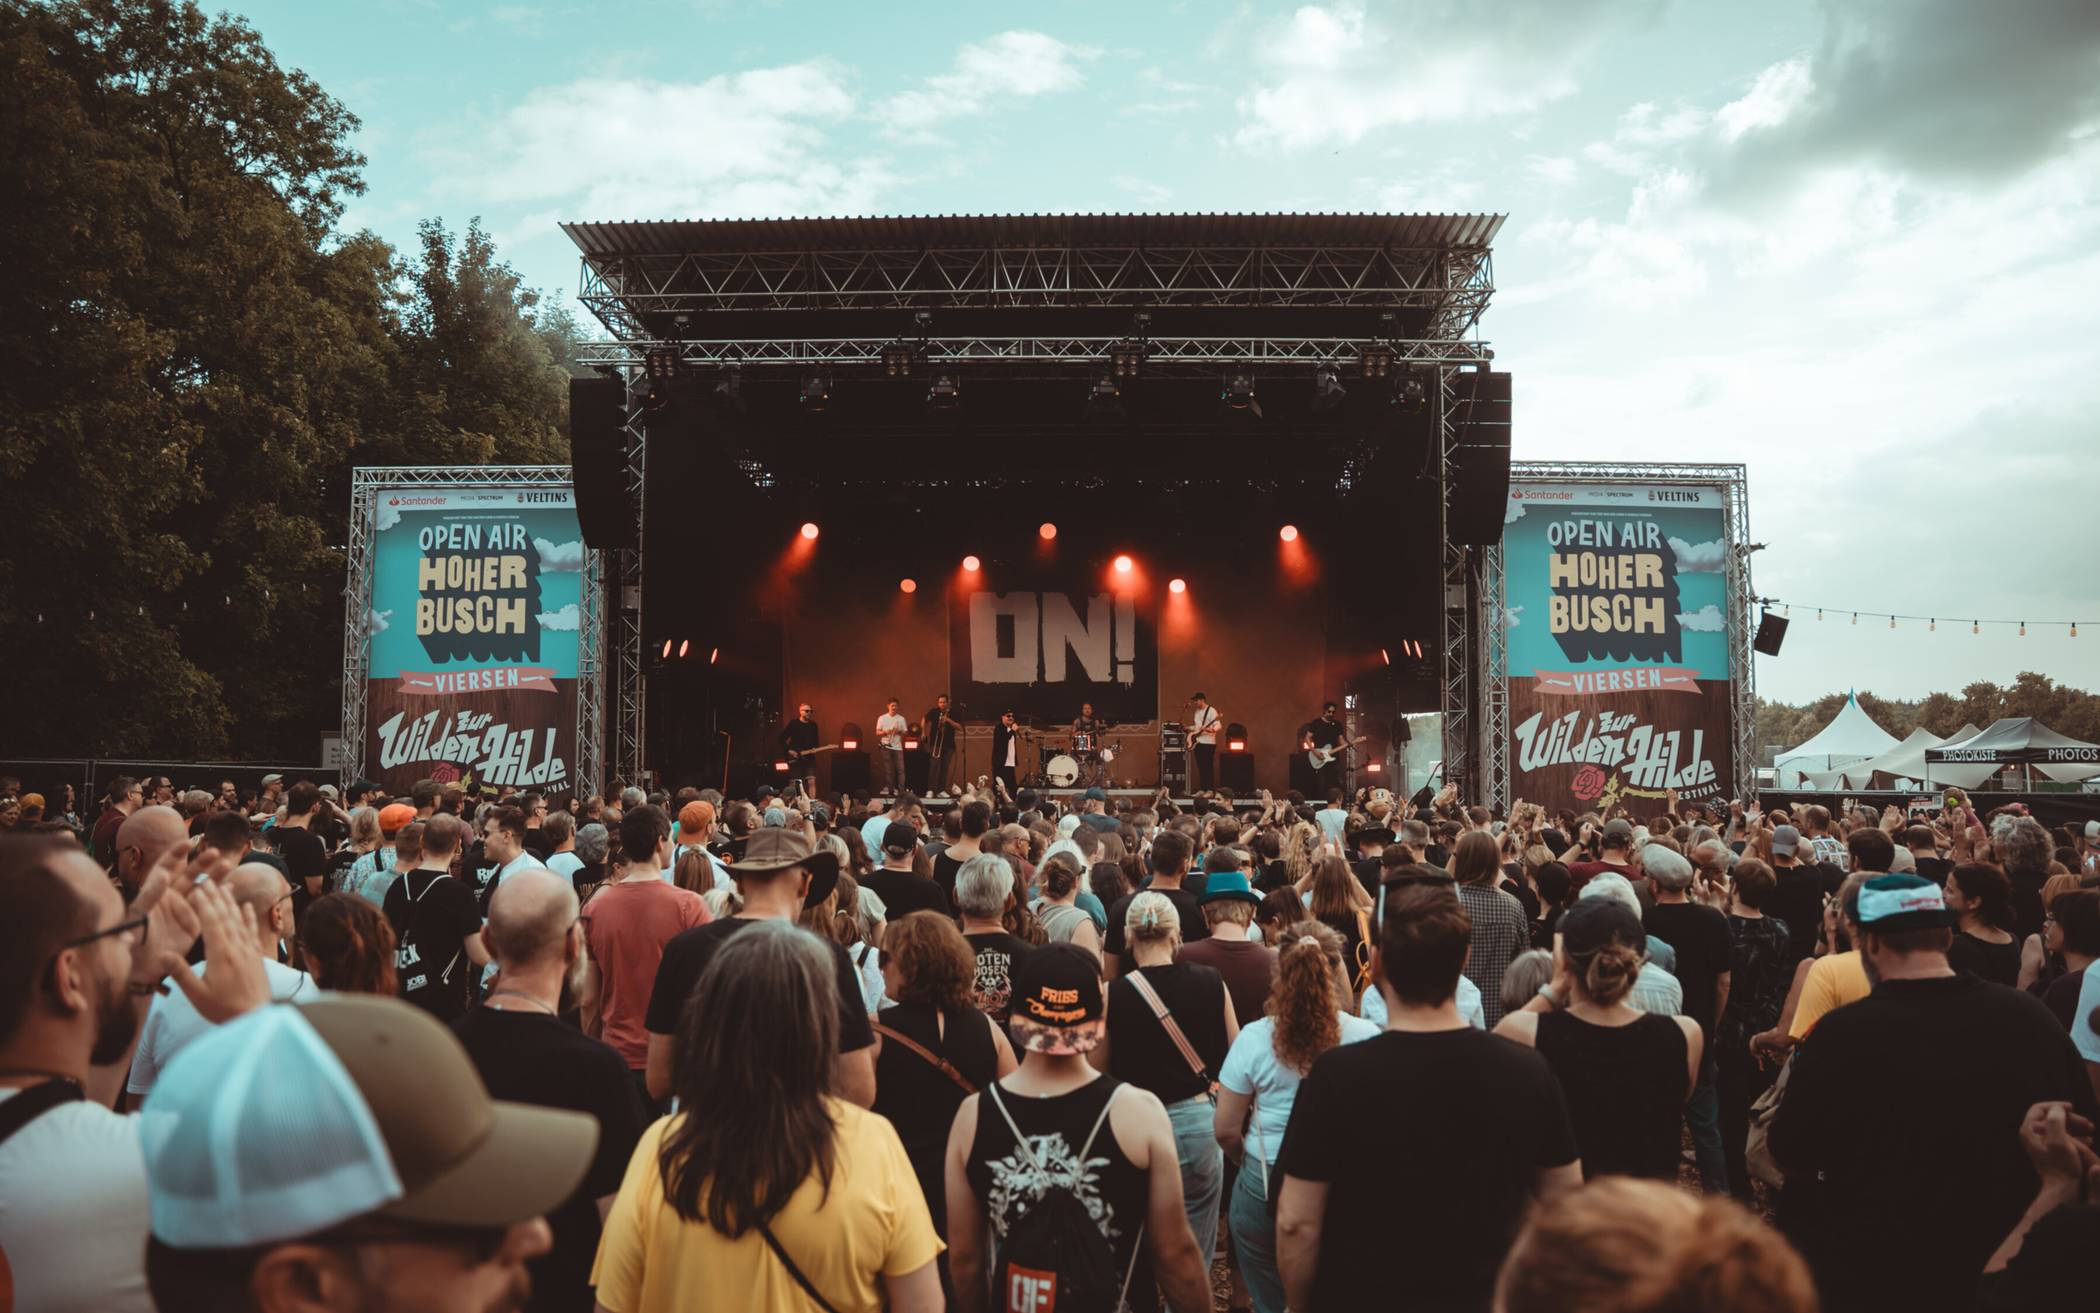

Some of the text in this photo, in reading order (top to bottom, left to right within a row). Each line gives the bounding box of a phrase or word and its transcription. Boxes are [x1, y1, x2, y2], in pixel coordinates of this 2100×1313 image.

[401, 496, 448, 505] Santander
[526, 492, 568, 503] VELTINS
[1525, 490, 1574, 500] Santander
[1657, 491, 1700, 503] VELTINS
[419, 522, 527, 551] OPEN AIR
[1547, 519, 1662, 549] OPEN AIR
[418, 554, 527, 592] HOHER
[1549, 551, 1665, 590] HOHER
[416, 595, 526, 636] BUSCH
[1549, 593, 1666, 634] BUSCH
[434, 668, 518, 693] VIERSEN
[1572, 668, 1661, 693] VIERSEN
[377, 709, 481, 770] Wilden
[1514, 710, 1626, 773] Wilden
[474, 723, 567, 786] Hilde
[1621, 724, 1717, 789] Hilde
[1943, 750, 1997, 761] PHOTOKISTE
[2048, 748, 2098, 761] PHOTOS
[1677, 782, 1722, 800] ESTIVAL
[976, 953, 1011, 966] OTEN
[1041, 986, 1078, 1004] FRIES
